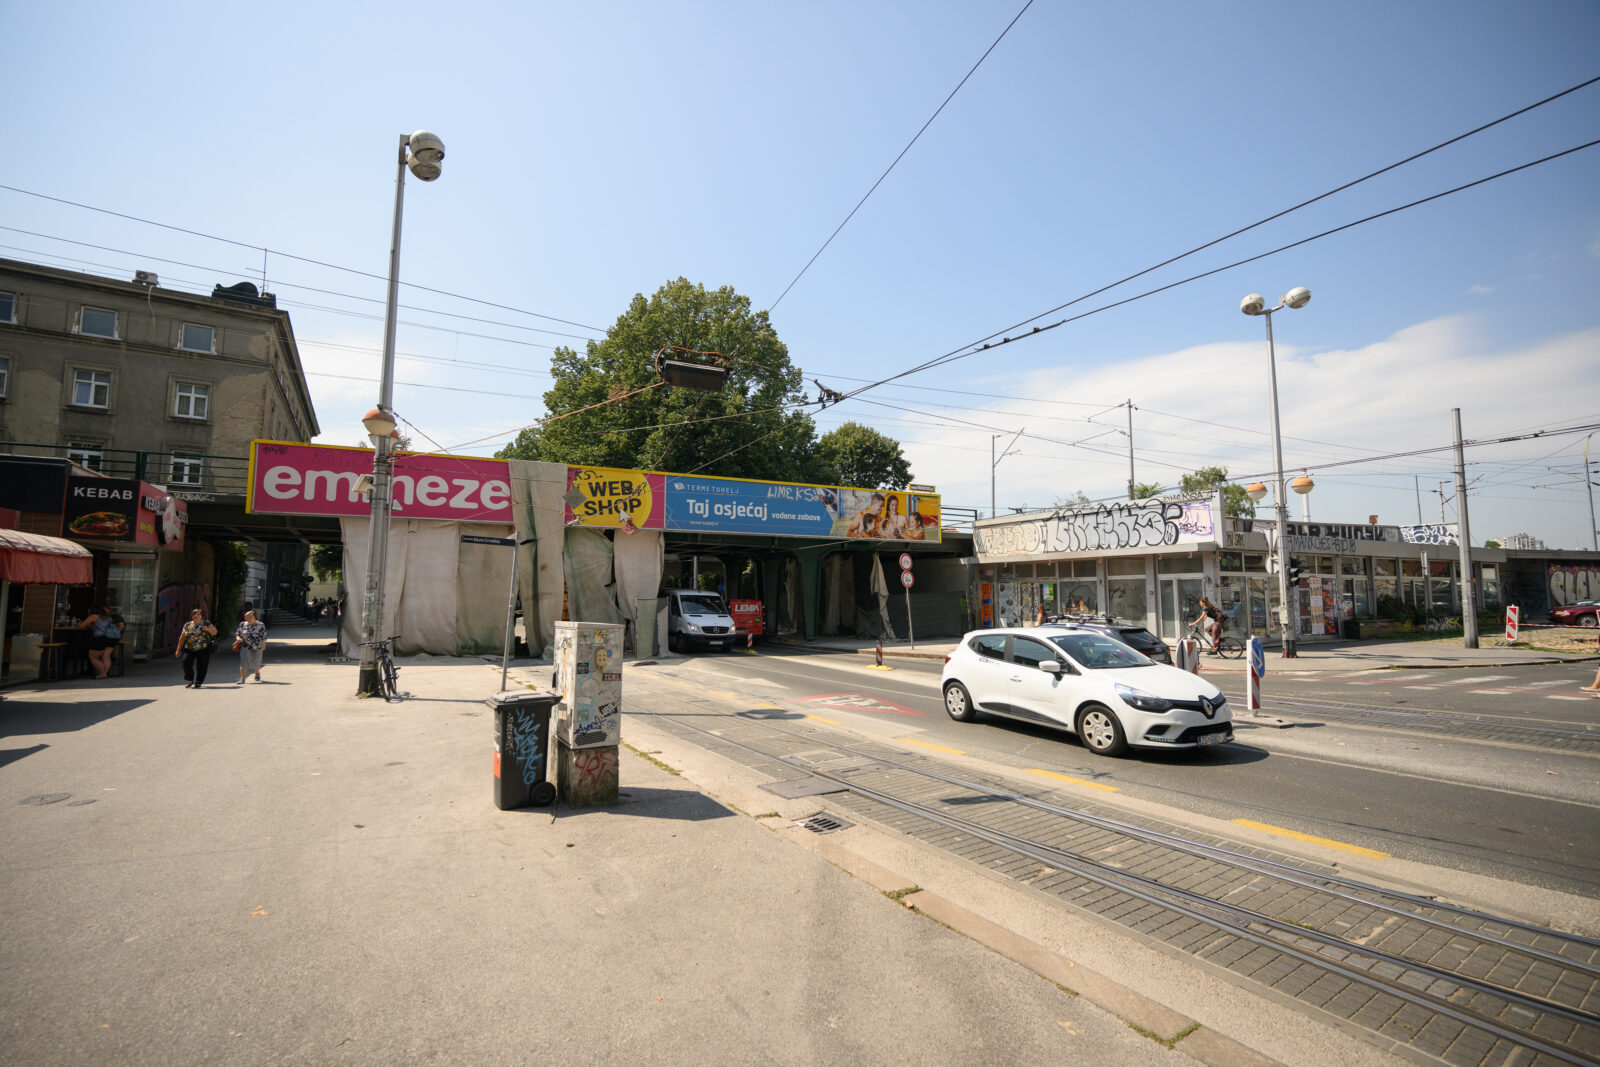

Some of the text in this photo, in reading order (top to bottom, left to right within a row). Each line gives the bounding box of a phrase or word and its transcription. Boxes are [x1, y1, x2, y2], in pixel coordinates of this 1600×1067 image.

[73, 486, 133, 500] KEBAB
[588, 480, 633, 497] WEB
[711, 486, 740, 494] TUHELJ
[584, 497, 642, 516] SHOP
[686, 499, 710, 518] Taj
[714, 501, 768, 521] osjećaj
